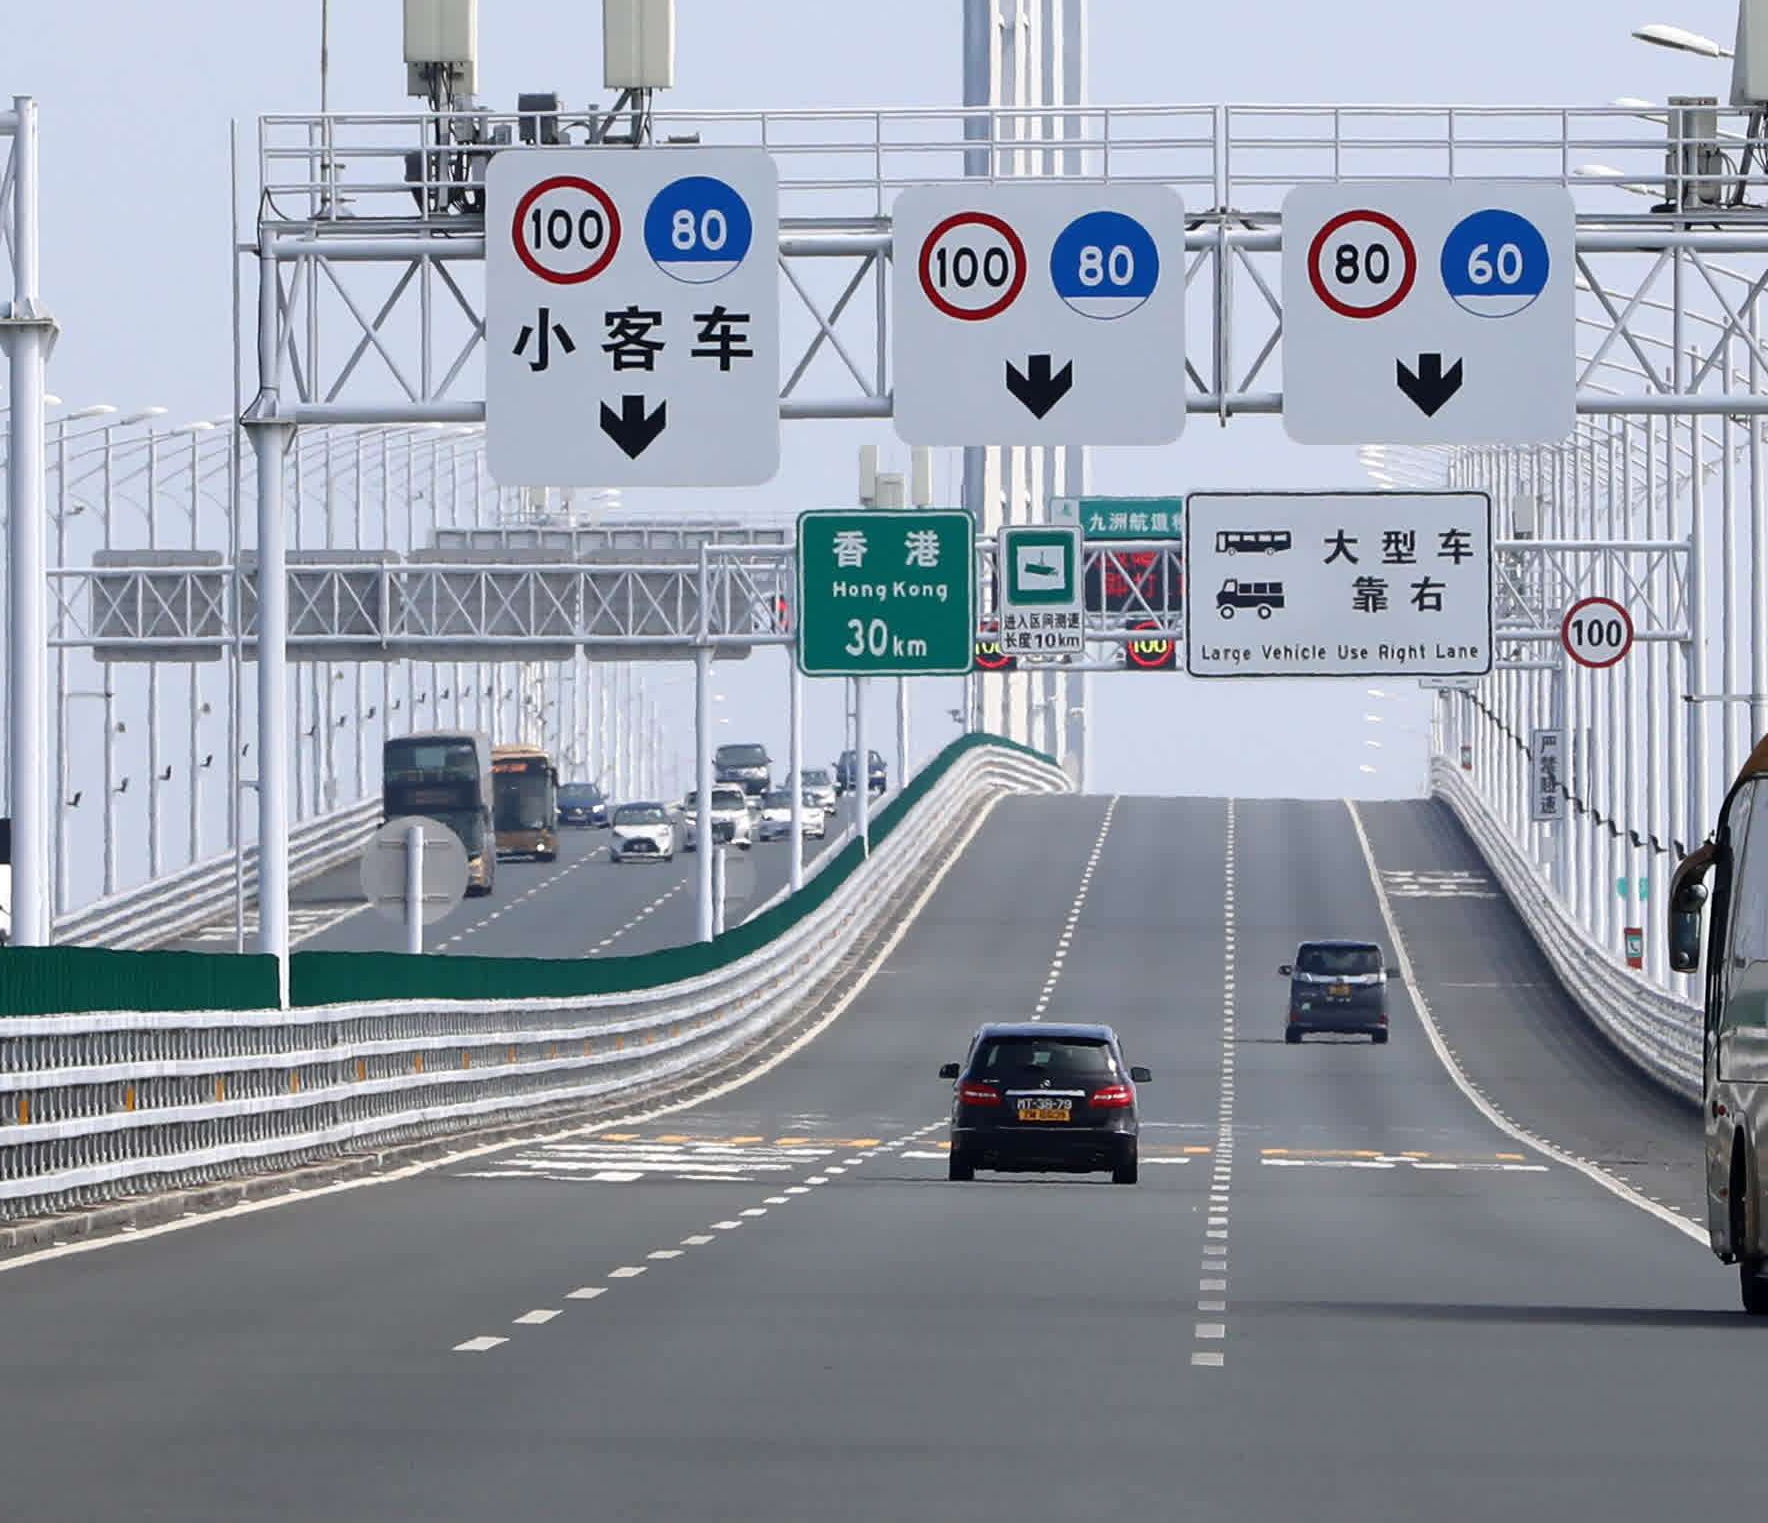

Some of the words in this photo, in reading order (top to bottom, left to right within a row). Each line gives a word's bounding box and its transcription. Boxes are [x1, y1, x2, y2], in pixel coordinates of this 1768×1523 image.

[531, 208, 604, 250] 100
[671, 209, 728, 251] 80
[936, 246, 1009, 289] 100
[1078, 245, 1135, 287] 80
[1335, 243, 1390, 285] 80
[1467, 243, 1523, 285] 60
[512, 305, 754, 372] 小客车
[832, 529, 940, 568] 香港
[1323, 528, 1474, 565] 大型车
[832, 580, 888, 599] Hong
[893, 580, 949, 600] Kong
[1351, 575, 1446, 614] 靠右
[1571, 619, 1623, 647] 100
[1201, 644, 1252, 665] Large
[1261, 644, 1327, 661] Vehicle
[1337, 644, 1369, 660] Use
[1378, 644, 1427, 664] Right
[1436, 644, 1479, 659] Lane
